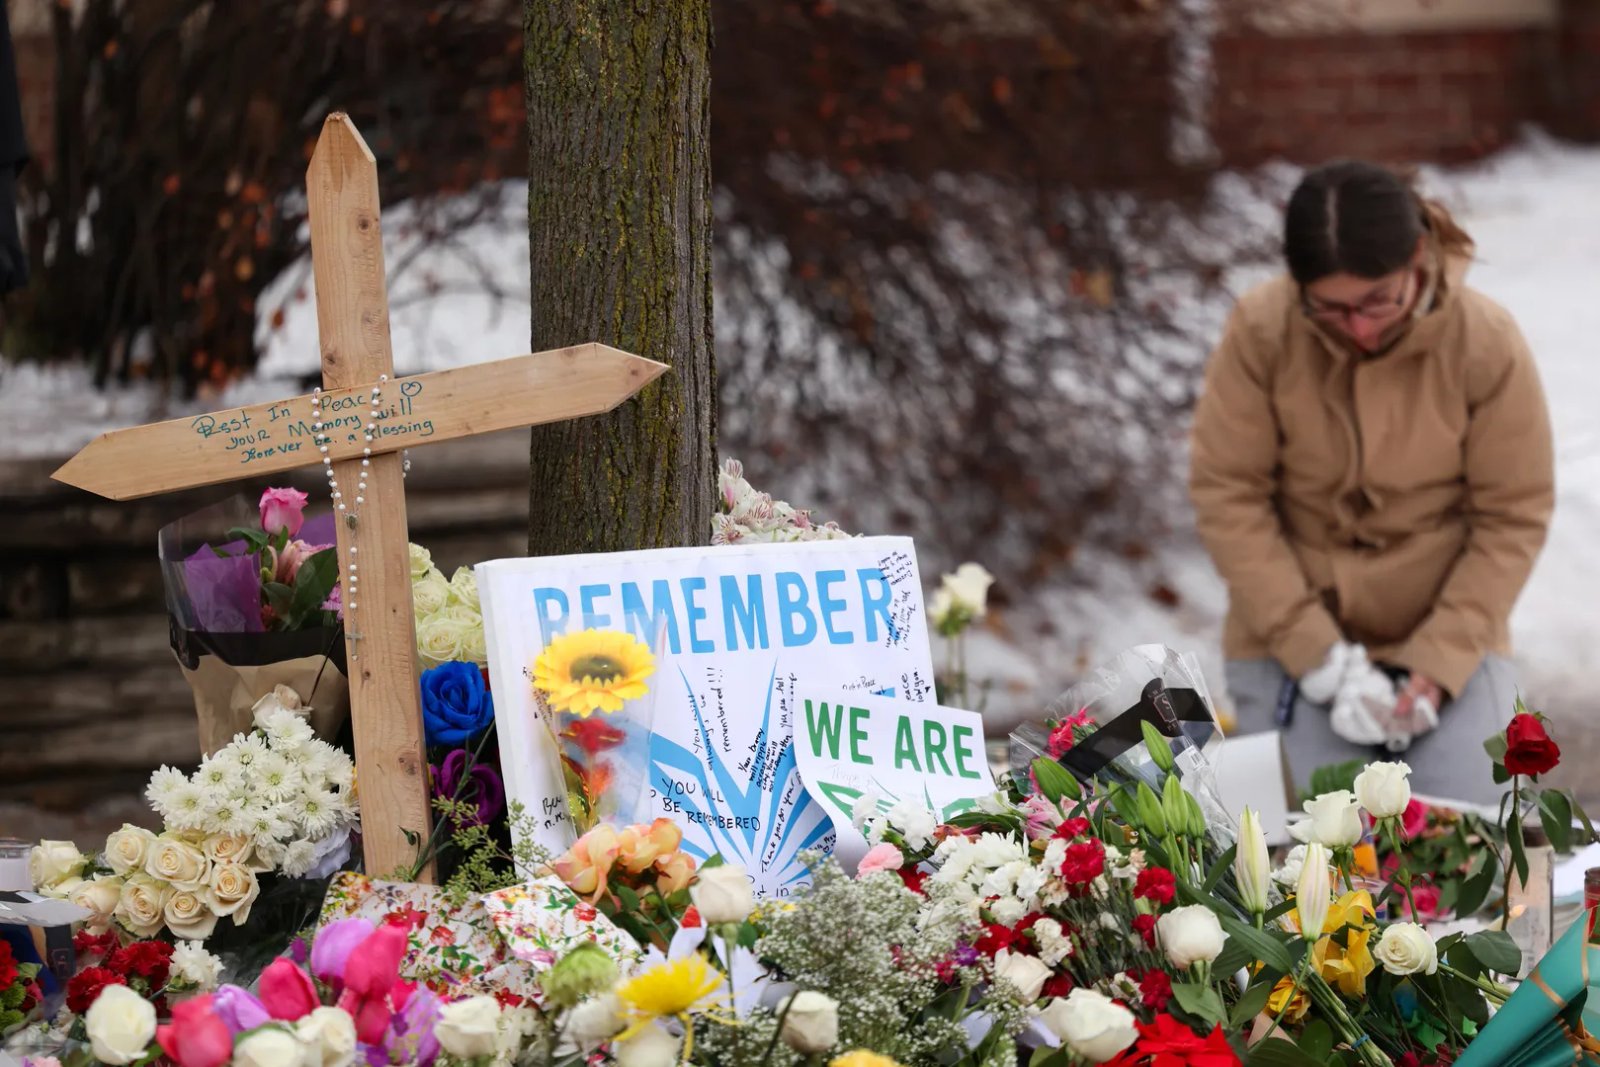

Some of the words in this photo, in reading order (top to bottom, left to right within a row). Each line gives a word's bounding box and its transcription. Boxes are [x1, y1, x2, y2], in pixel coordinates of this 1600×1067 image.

[191, 410, 252, 438] Rest
[267, 405, 291, 422] In
[288, 415, 362, 437] Memory
[375, 397, 412, 420] will
[533, 568, 901, 655] REMEMBER
[901, 672, 911, 701] eace
[804, 699, 874, 766] WE
[894, 715, 980, 780] ARE
[662, 778, 696, 797] YOU
[662, 797, 681, 813] BE
[685, 810, 761, 832] REMEMBERED
